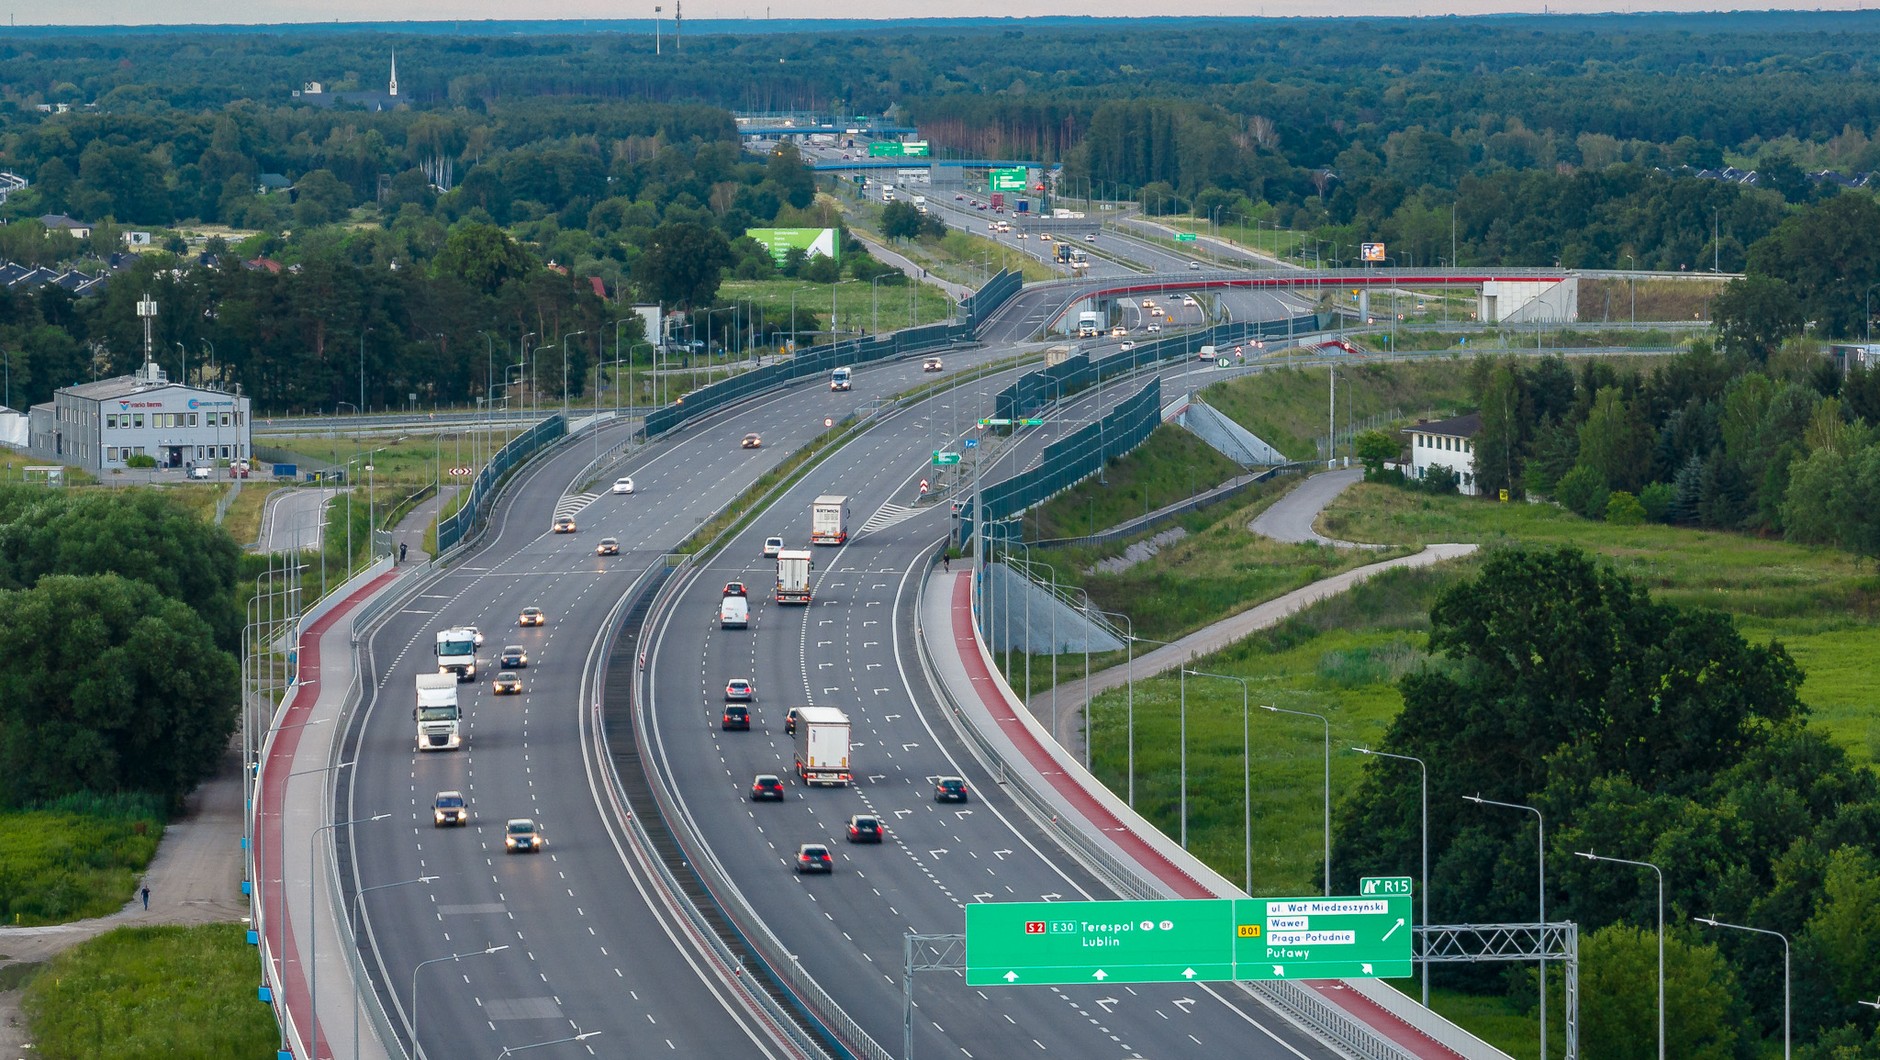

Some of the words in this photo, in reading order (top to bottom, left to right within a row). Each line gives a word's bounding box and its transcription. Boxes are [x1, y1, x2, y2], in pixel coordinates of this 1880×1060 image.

[1384, 880, 1409, 892] R15
[1288, 904, 1307, 912] Wał
[1312, 902, 1384, 913] Miedzeszyński
[1028, 923, 1035, 932] S
[1037, 923, 1043, 932] 2
[1052, 923, 1058, 932] E
[1060, 923, 1073, 932] 30
[1081, 921, 1134, 934] Terespol
[1271, 919, 1304, 927] Wawer
[1240, 927, 1258, 935] 801
[1082, 936, 1120, 947] Lublin
[1271, 933, 1351, 944] Praga-Południe
[1266, 947, 1310, 960] Puławy
